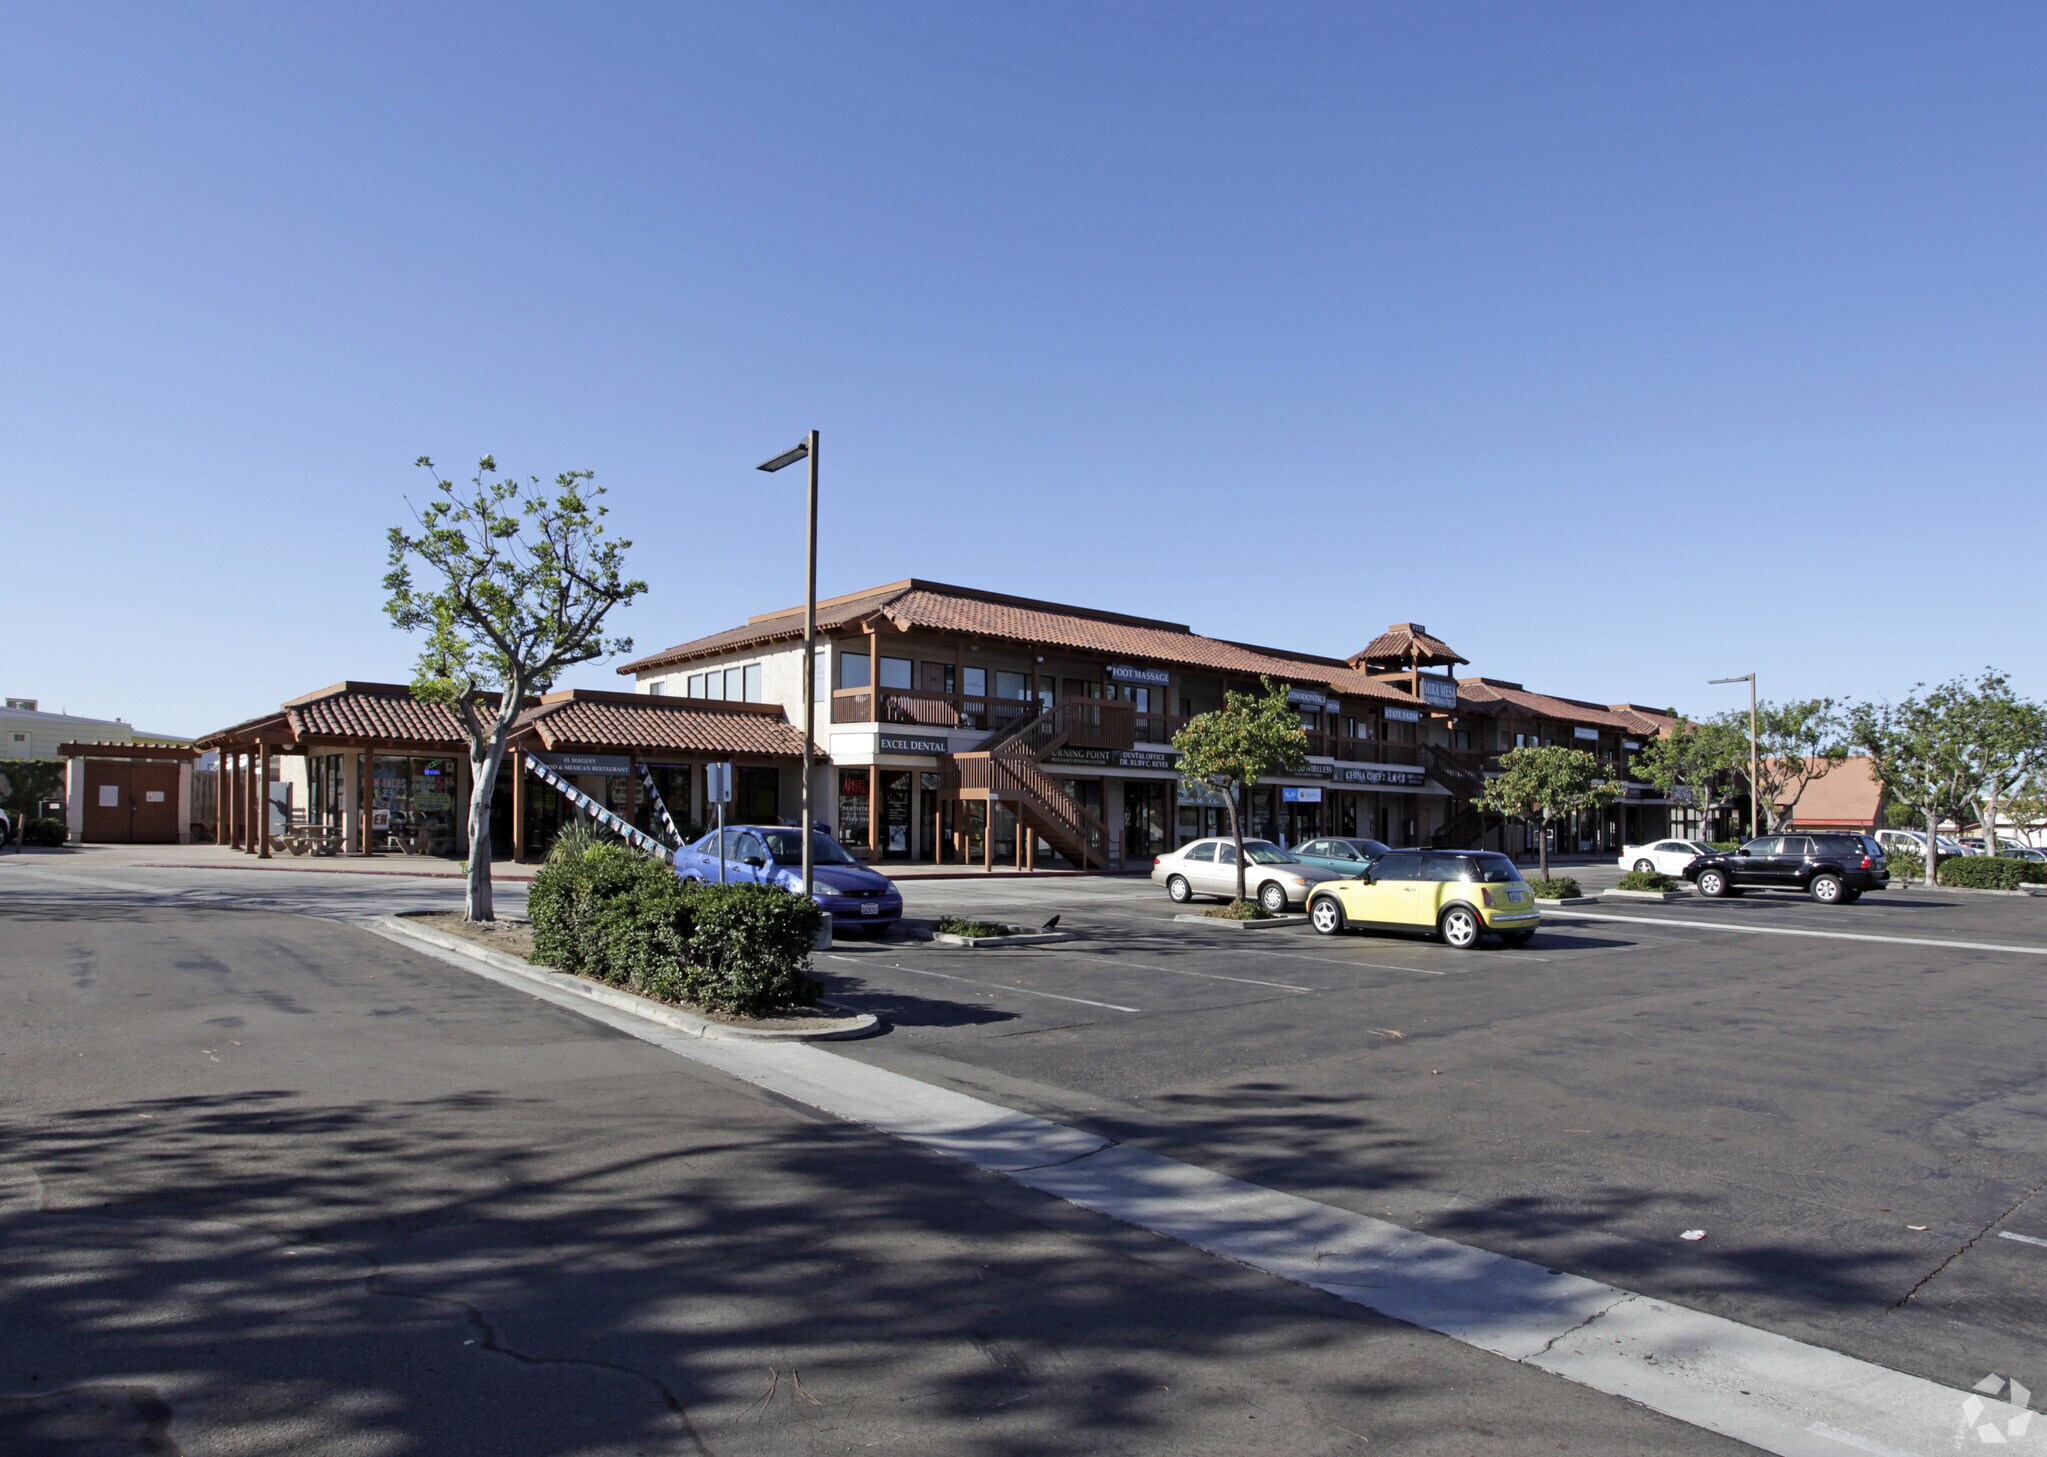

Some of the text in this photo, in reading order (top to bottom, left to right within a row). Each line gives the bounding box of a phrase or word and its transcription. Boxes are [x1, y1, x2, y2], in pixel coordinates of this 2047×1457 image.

[1112, 667, 1169, 682] FOOT MASSAGE
[1424, 682, 1456, 700] MIRA MESA
[1288, 691, 1326, 704] THODONTICS
[1384, 709, 1419, 721] STATE FARM
[881, 739, 946, 752] EXCEL DENTAL
[1051, 748, 1110, 760] URNING POINT
[1123, 751, 1165, 761] DENTAL OFFICE
[1130, 759, 1145, 767] RUBY
[1306, 765, 1333, 774] WIRELESS
[1345, 771, 1366, 780] CHINA
[1366, 772, 1382, 782] CHEF
